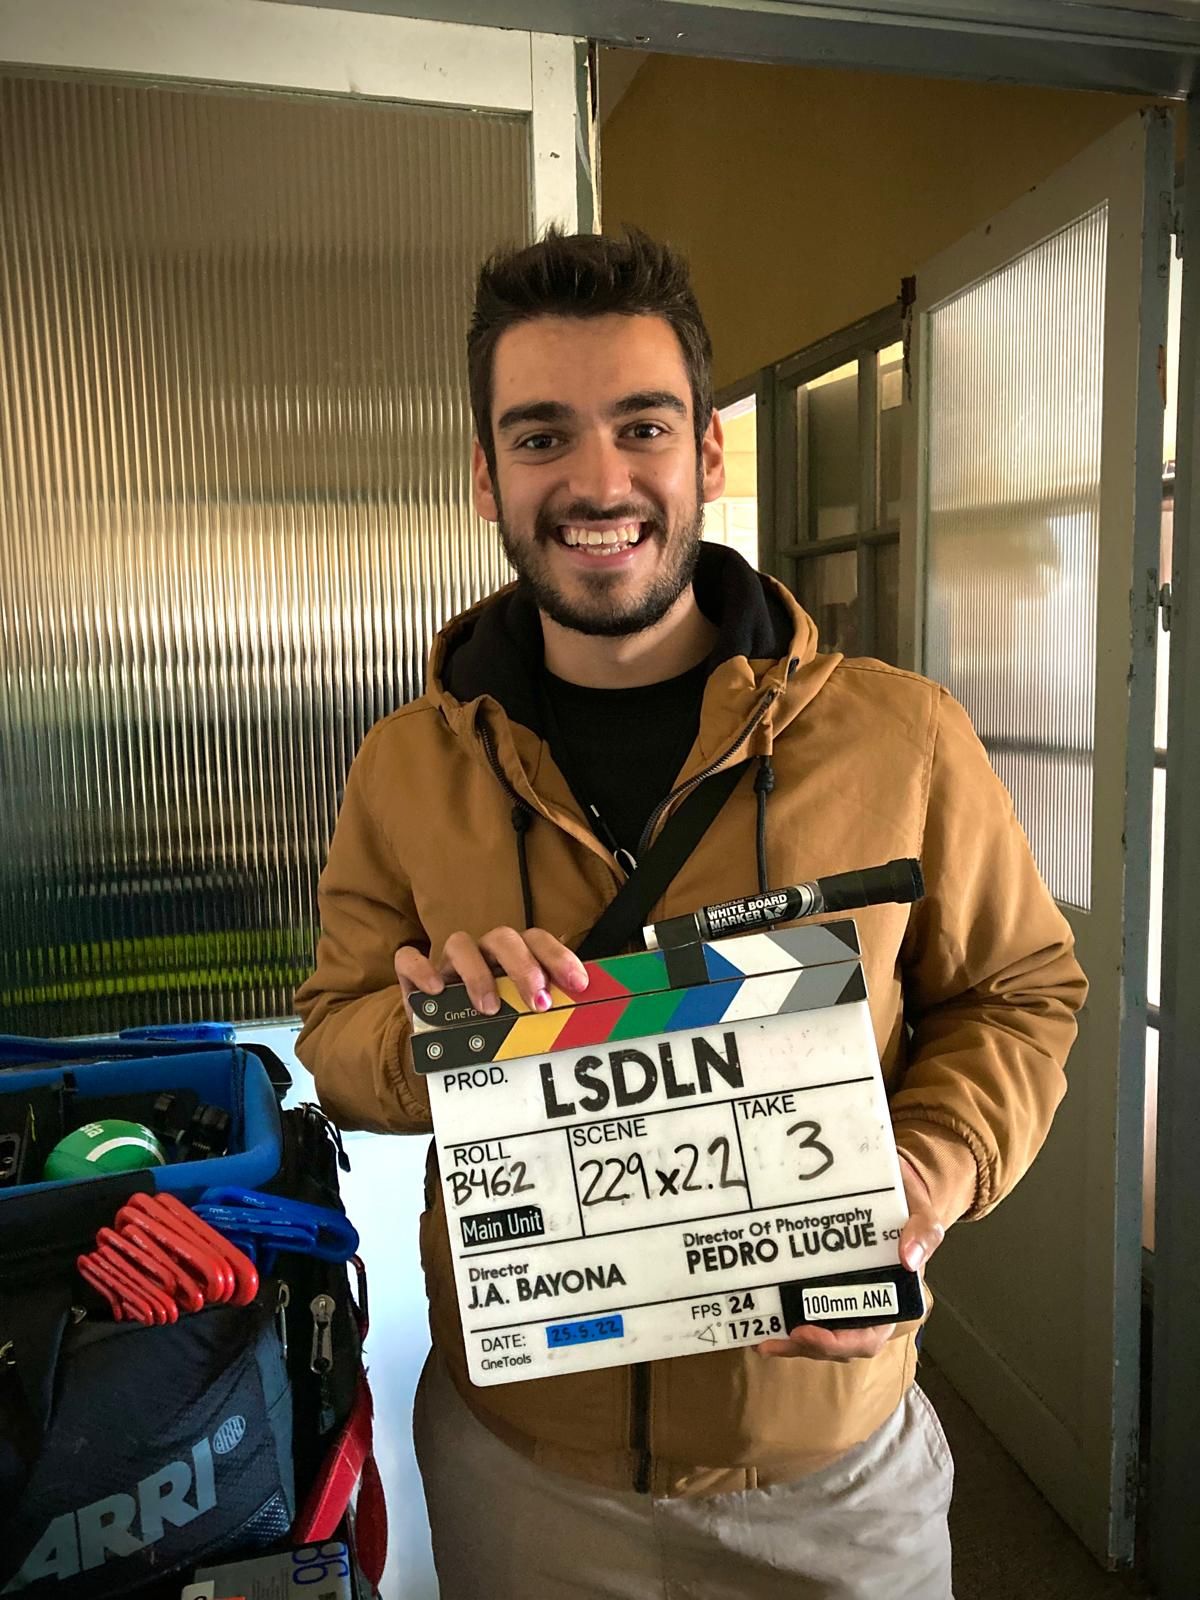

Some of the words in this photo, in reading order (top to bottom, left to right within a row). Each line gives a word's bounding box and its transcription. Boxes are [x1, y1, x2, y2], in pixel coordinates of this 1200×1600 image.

[707, 903, 745, 920] WHITE
[747, 893, 788, 911] BOARD
[709, 910, 761, 931] MARKER
[444, 1007, 480, 1022] CineTo
[443, 1066, 508, 1093] PROD.
[539, 1031, 745, 1119] LSDLN
[738, 1094, 797, 1120] TAKE
[573, 1118, 648, 1147] SCENE
[453, 1142, 511, 1167] ROLL
[786, 1120, 834, 1181] 3
[446, 1161, 535, 1206] B462
[462, 1217, 504, 1243] Main
[507, 1211, 543, 1235] Unit
[683, 1228, 744, 1248] Director
[749, 1221, 772, 1237] Of
[776, 1207, 873, 1234] Photography
[686, 1239, 779, 1275] PEDRO
[789, 1222, 878, 1258] LUQUE
[468, 1263, 529, 1282] Director
[468, 1283, 510, 1309] J.A.
[516, 1263, 627, 1302] BAYONA
[691, 1303, 722, 1320] FPS
[728, 1292, 755, 1314] 24
[804, 1295, 858, 1315] 100mm
[863, 1289, 893, 1309] ANA
[481, 1333, 527, 1352] DATE:
[481, 1354, 532, 1370] CineTools
[1, 1437, 217, 1594] ARRI
